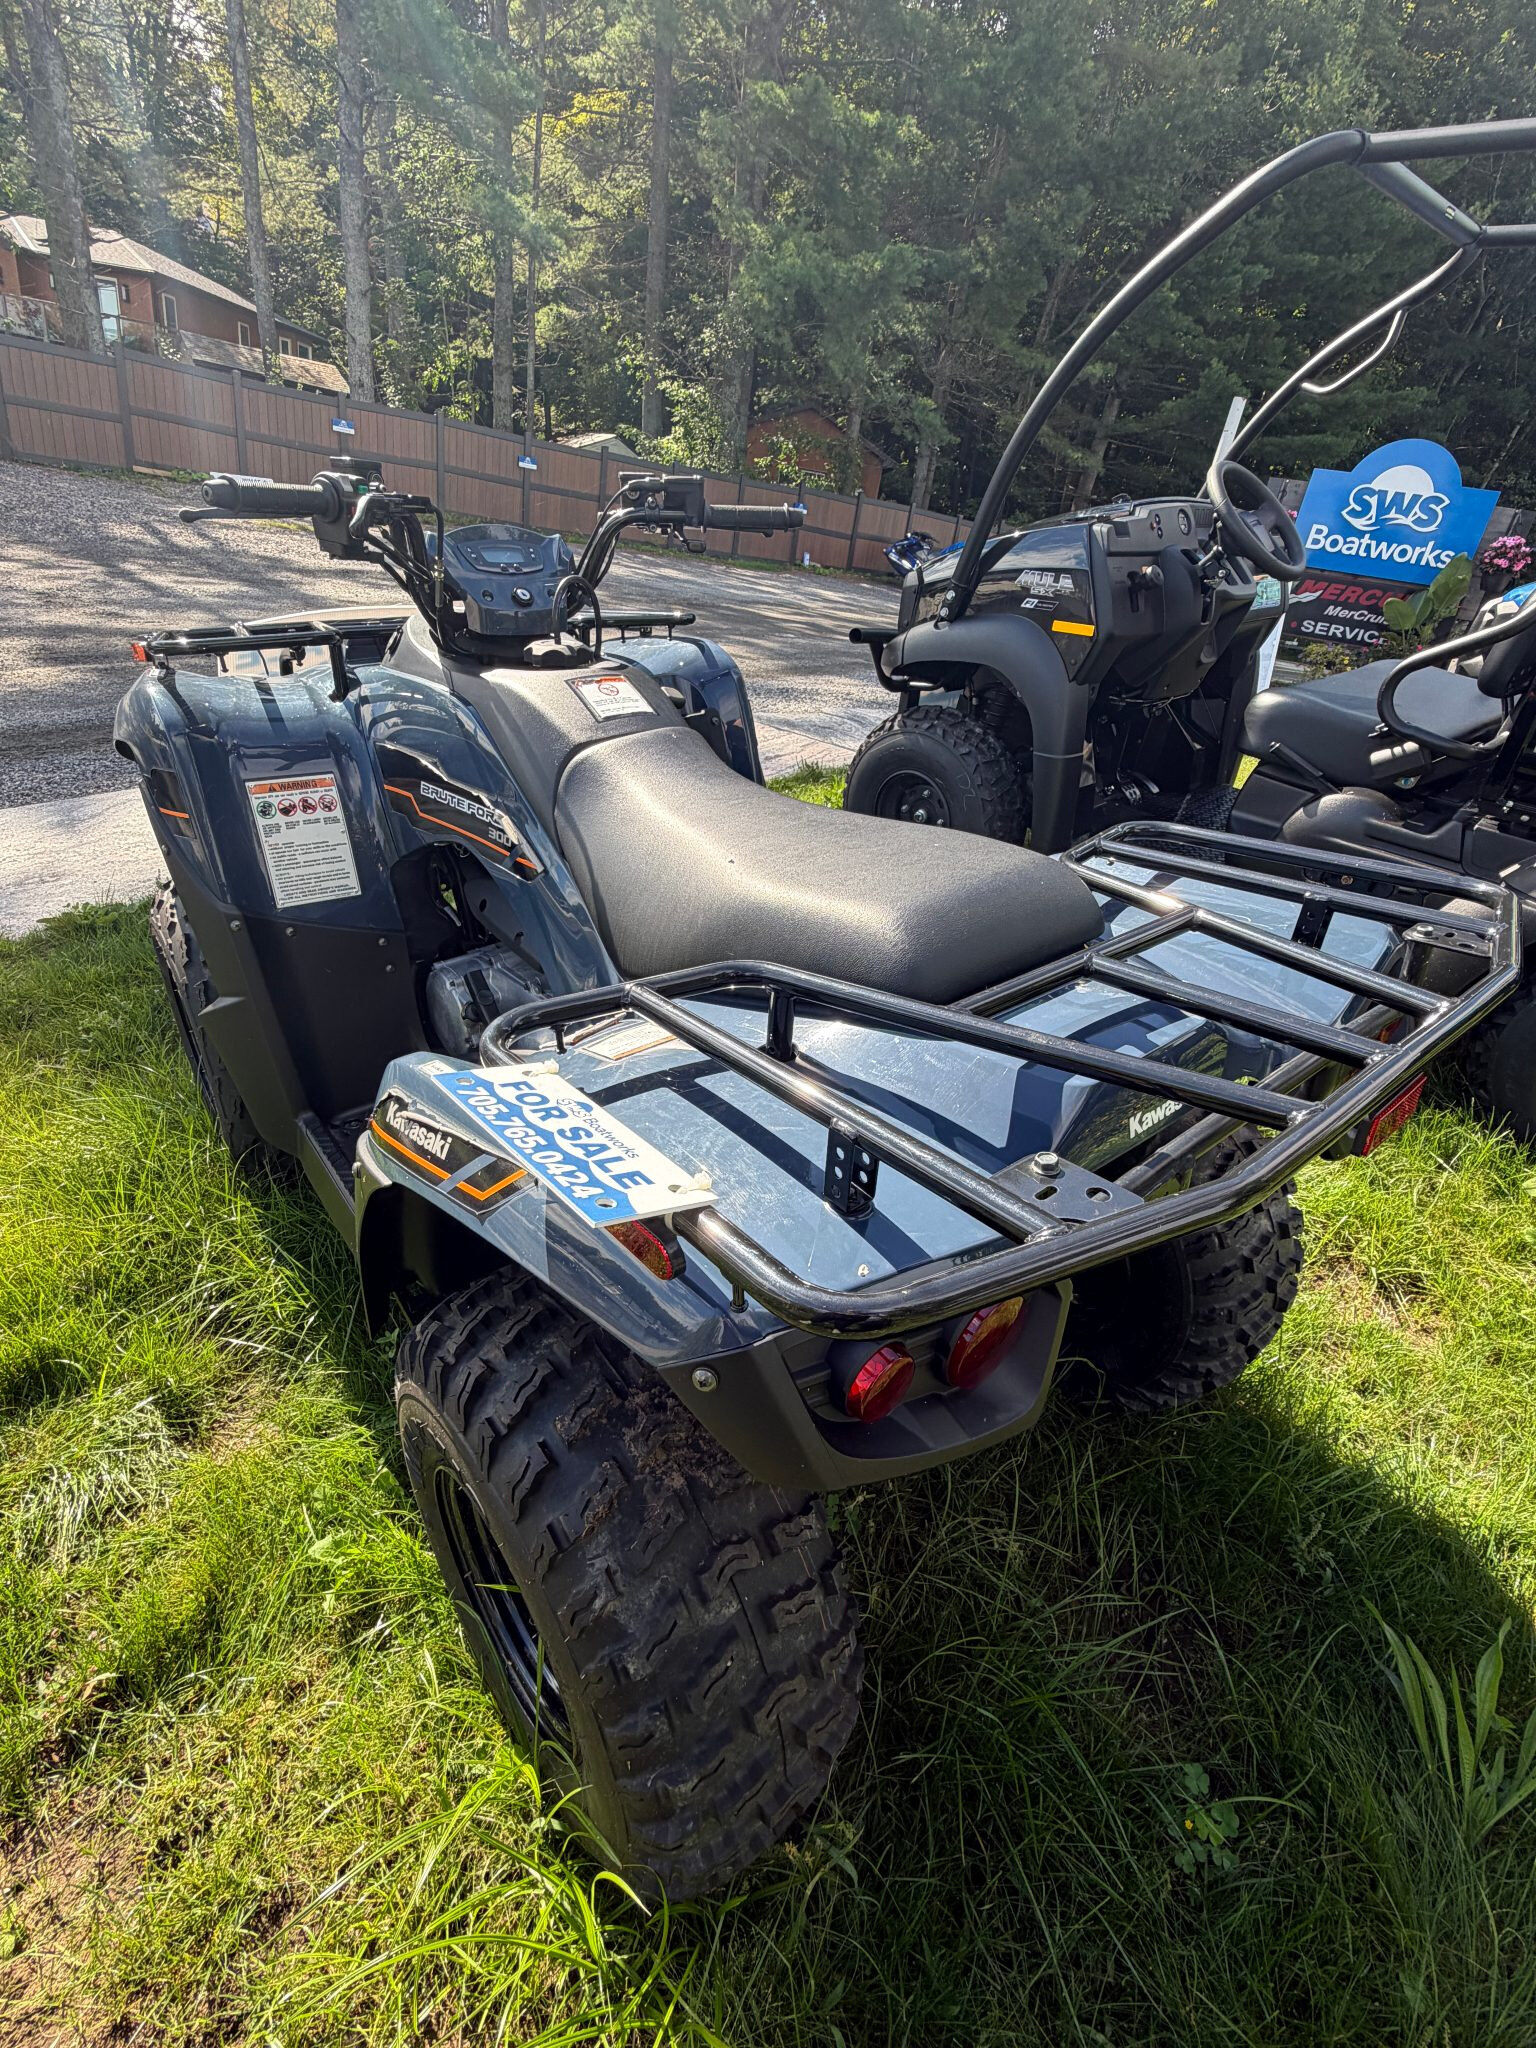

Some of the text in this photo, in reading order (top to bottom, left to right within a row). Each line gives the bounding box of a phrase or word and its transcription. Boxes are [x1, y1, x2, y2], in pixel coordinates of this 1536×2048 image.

[1341, 483, 1451, 532] SWS
[1305, 523, 1454, 569] Boatworks
[1015, 569, 1075, 592] MULE
[1300, 620, 1388, 645] SERVIC
[278, 780, 318, 792] WARNING
[488, 826, 512, 848] 300
[386, 1101, 453, 1161] Kawasaki
[498, 1080, 656, 1190] FOR SALE
[583, 1117, 640, 1160] Boatworks
[1129, 1099, 1183, 1139] Kawas
[455, 1086, 604, 1199] 705.765.0424
